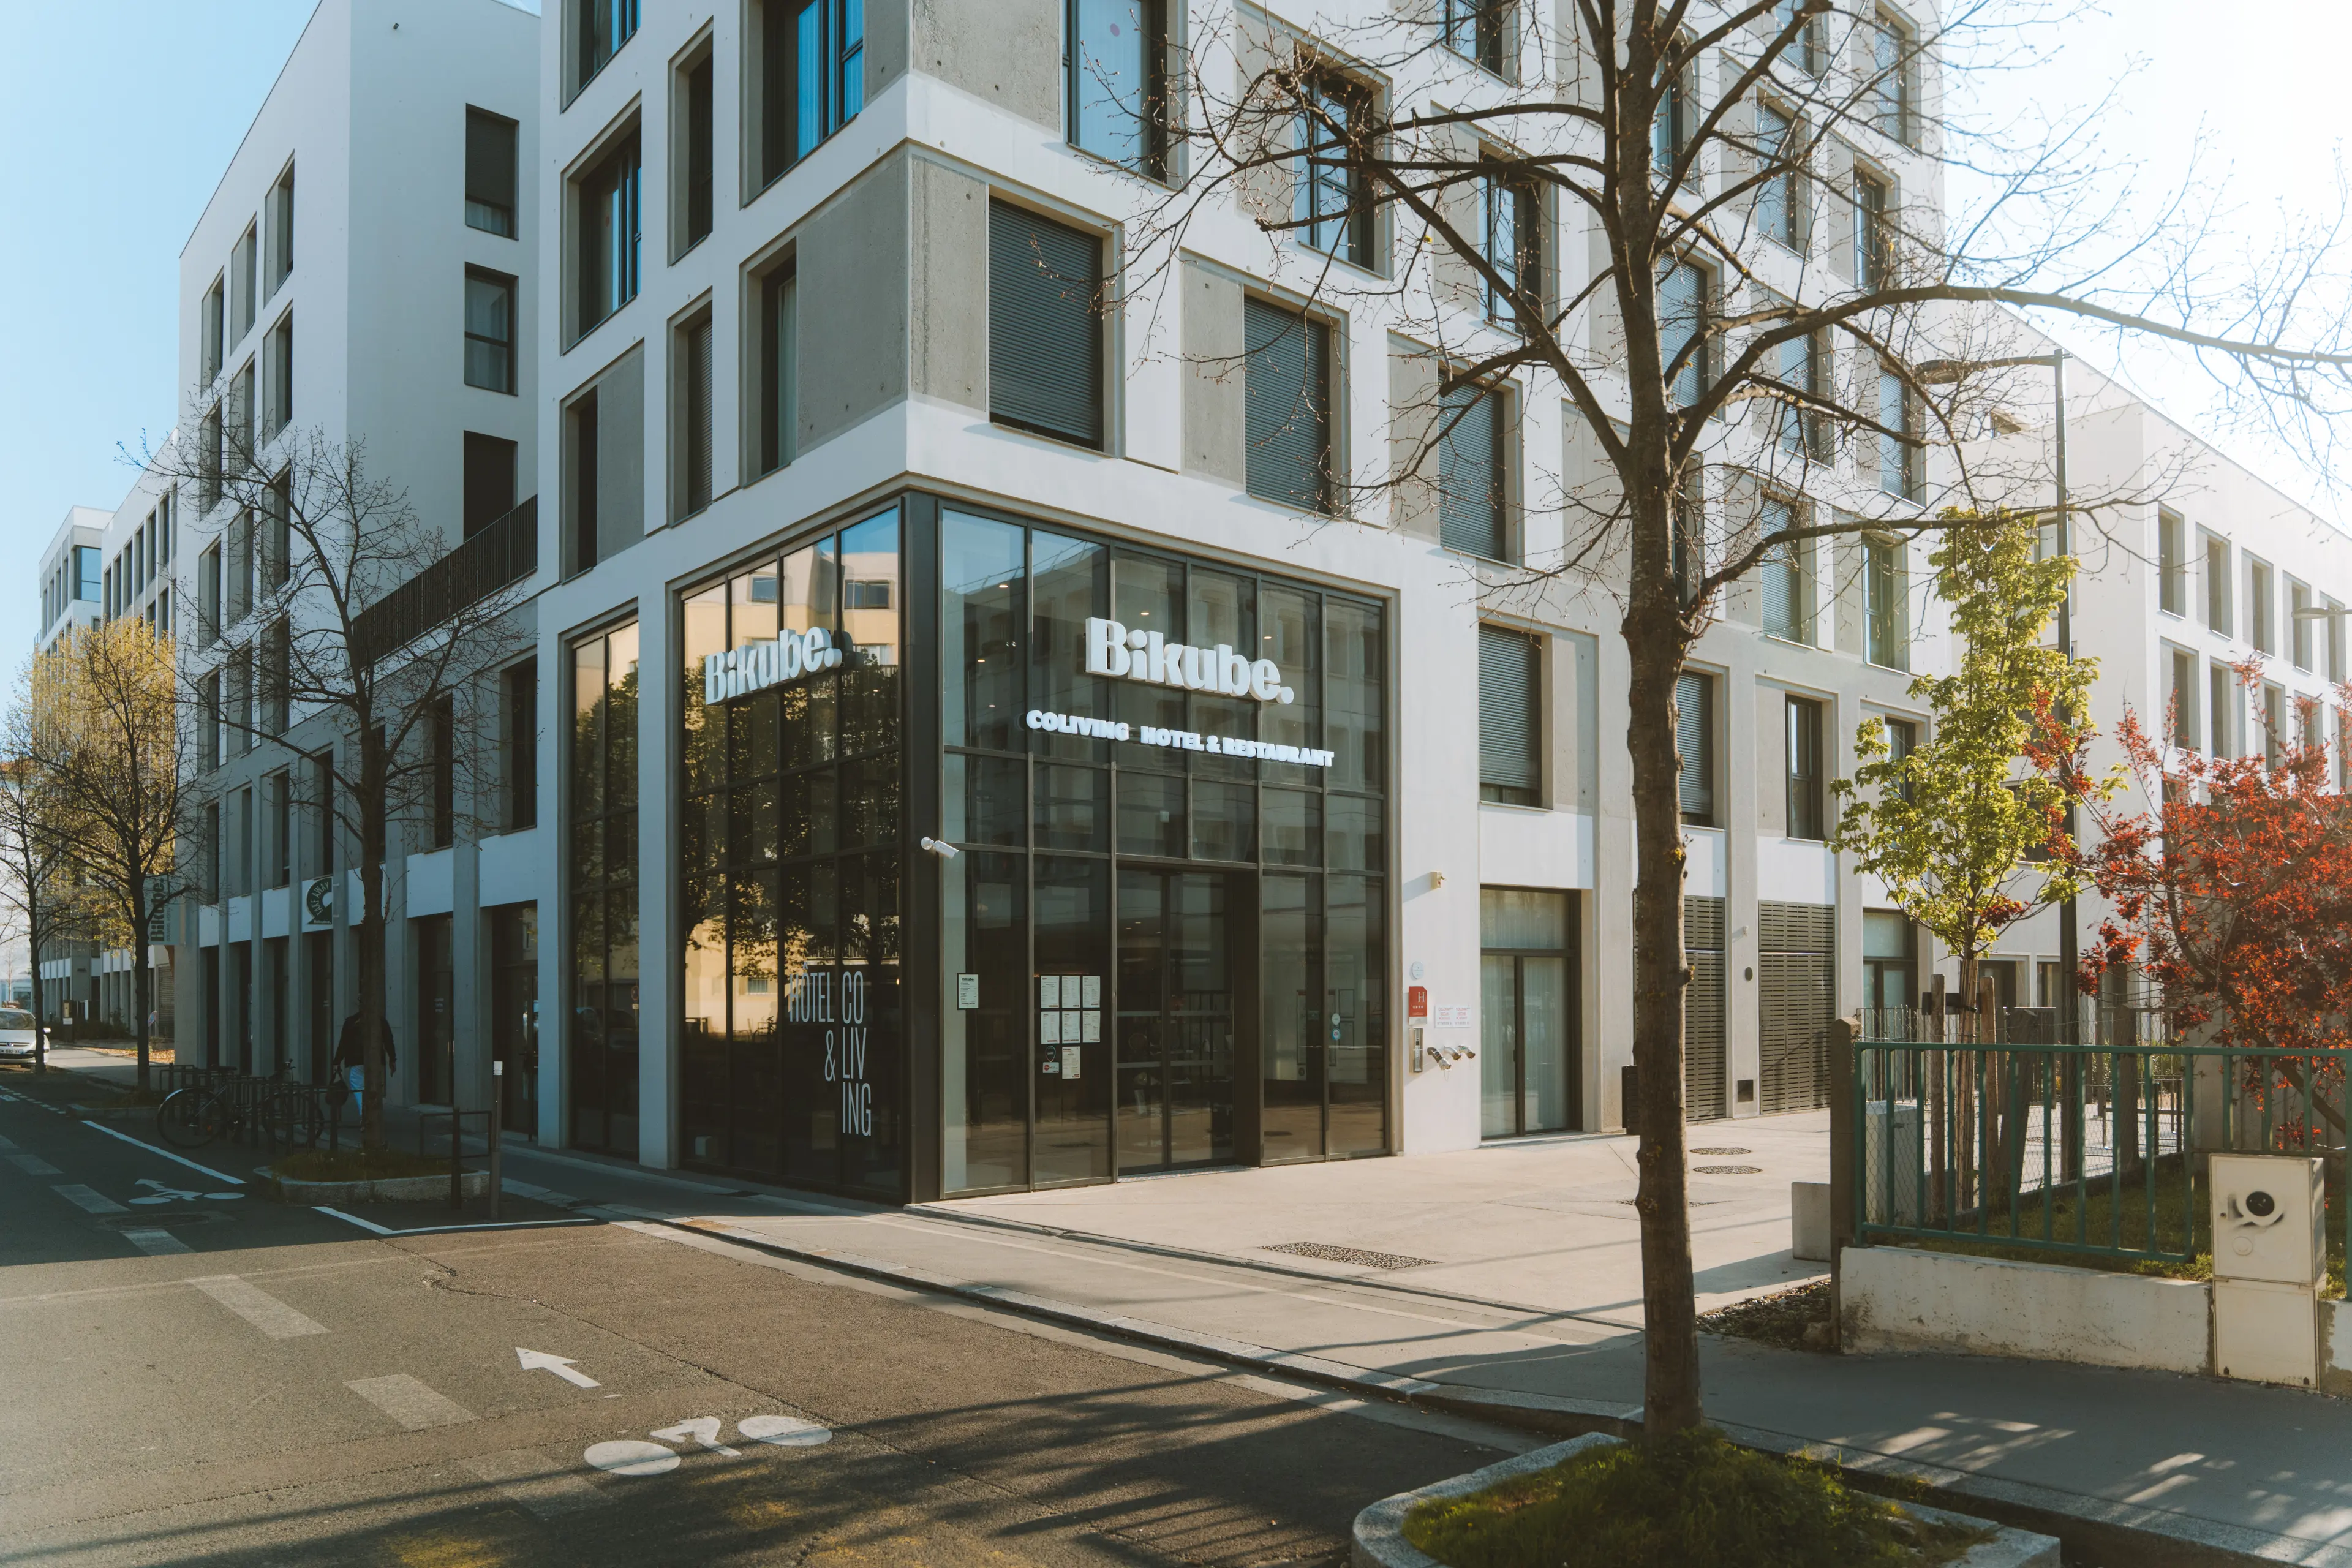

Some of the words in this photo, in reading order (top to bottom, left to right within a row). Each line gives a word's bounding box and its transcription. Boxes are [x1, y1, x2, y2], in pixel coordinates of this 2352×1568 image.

[706, 627, 842, 704] Bikube.
[1086, 617, 1294, 704] Bikube.
[1026, 710, 1129, 741] COLIVING
[1140, 726, 1204, 751] HOTEL
[1206, 735, 1222, 753] &
[1222, 737, 1335, 767] RESTAURANT
[310, 899, 323, 916] TAKE
[311, 881, 329, 898] AWAY
[790, 962, 834, 1022] HÔTEL
[842, 971, 864, 1024] CO
[1417, 992, 1425, 1003] H
[824, 1030, 836, 1082] &
[842, 1027, 867, 1080] LIV
[842, 1081, 872, 1137] ING
